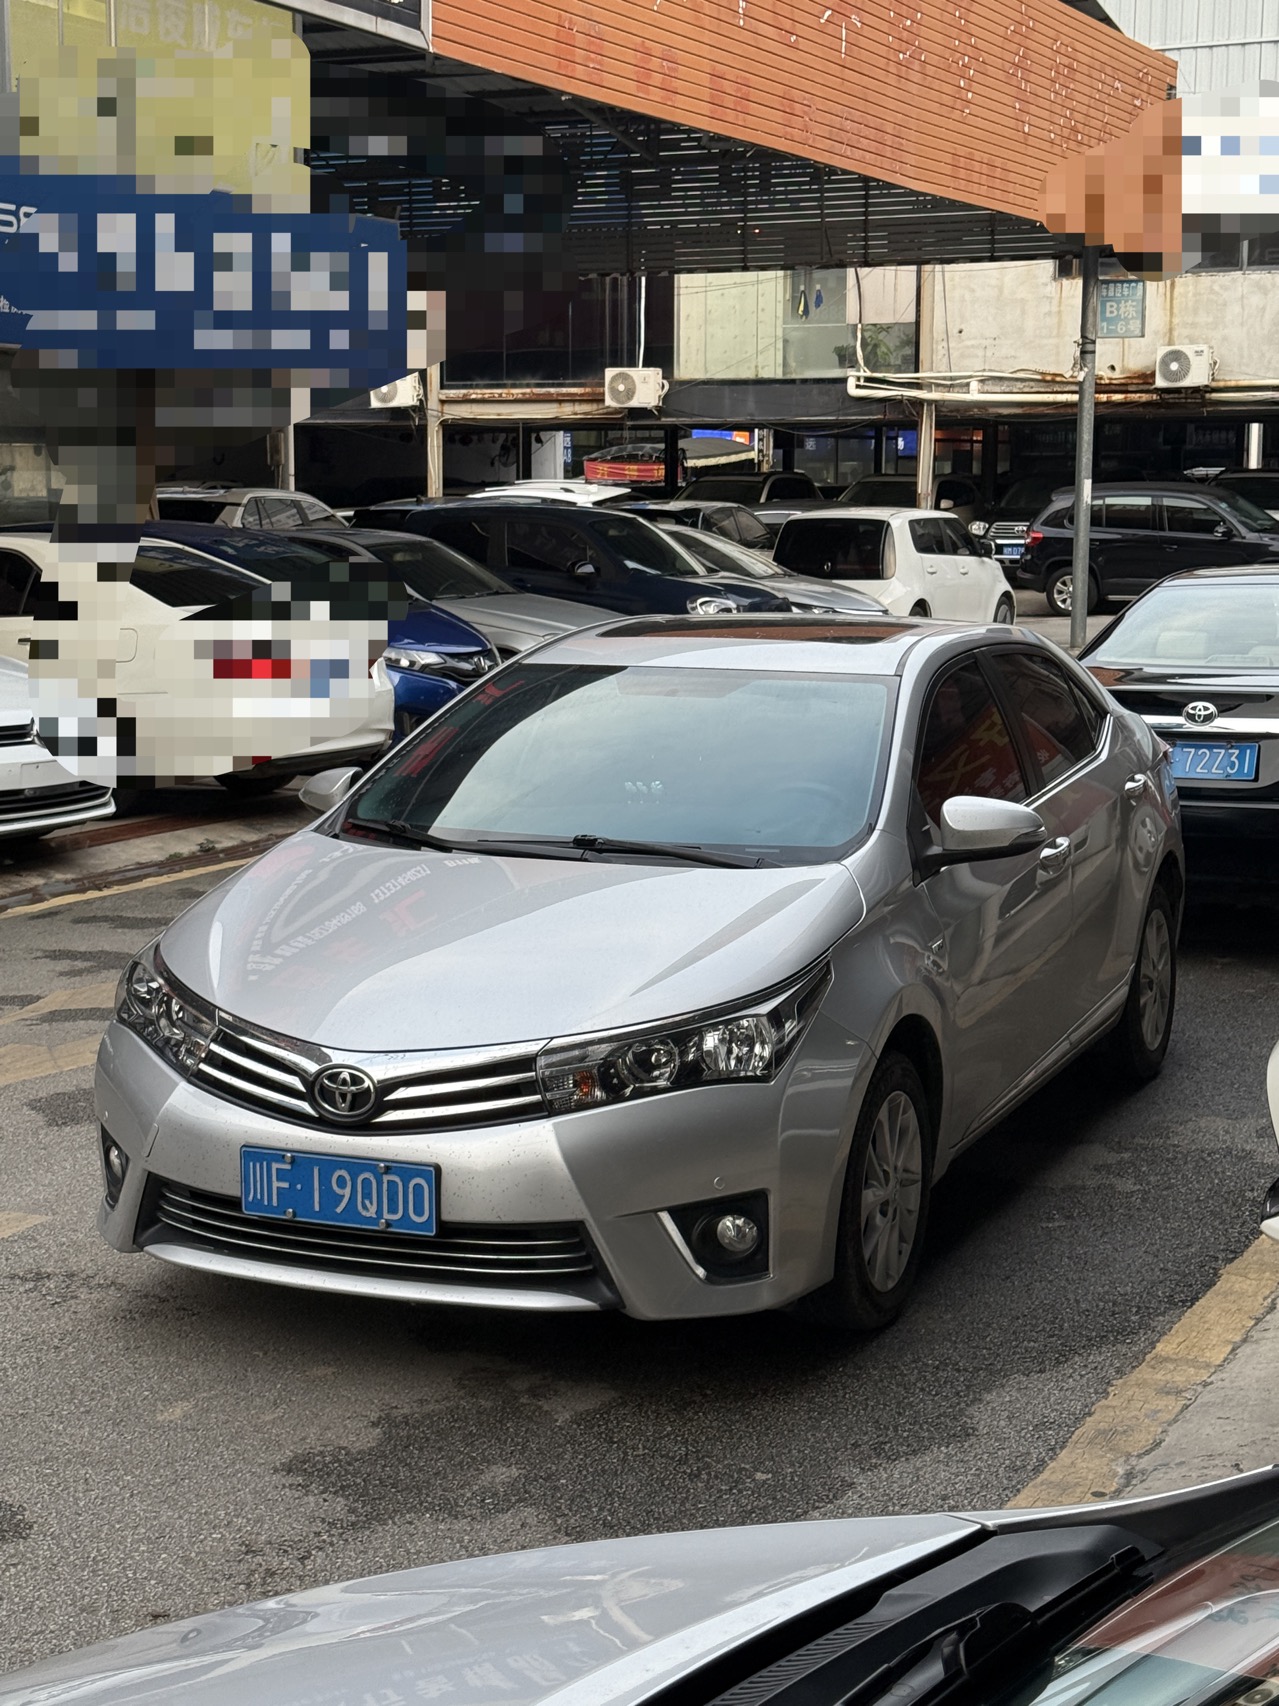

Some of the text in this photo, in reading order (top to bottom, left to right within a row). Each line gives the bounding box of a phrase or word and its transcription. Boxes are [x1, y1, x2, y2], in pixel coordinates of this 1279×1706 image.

[1106, 300, 1137, 319] B栋
[1101, 320, 1141, 335] 1-6号
[1172, 748, 1250, 774] ·72Z31
